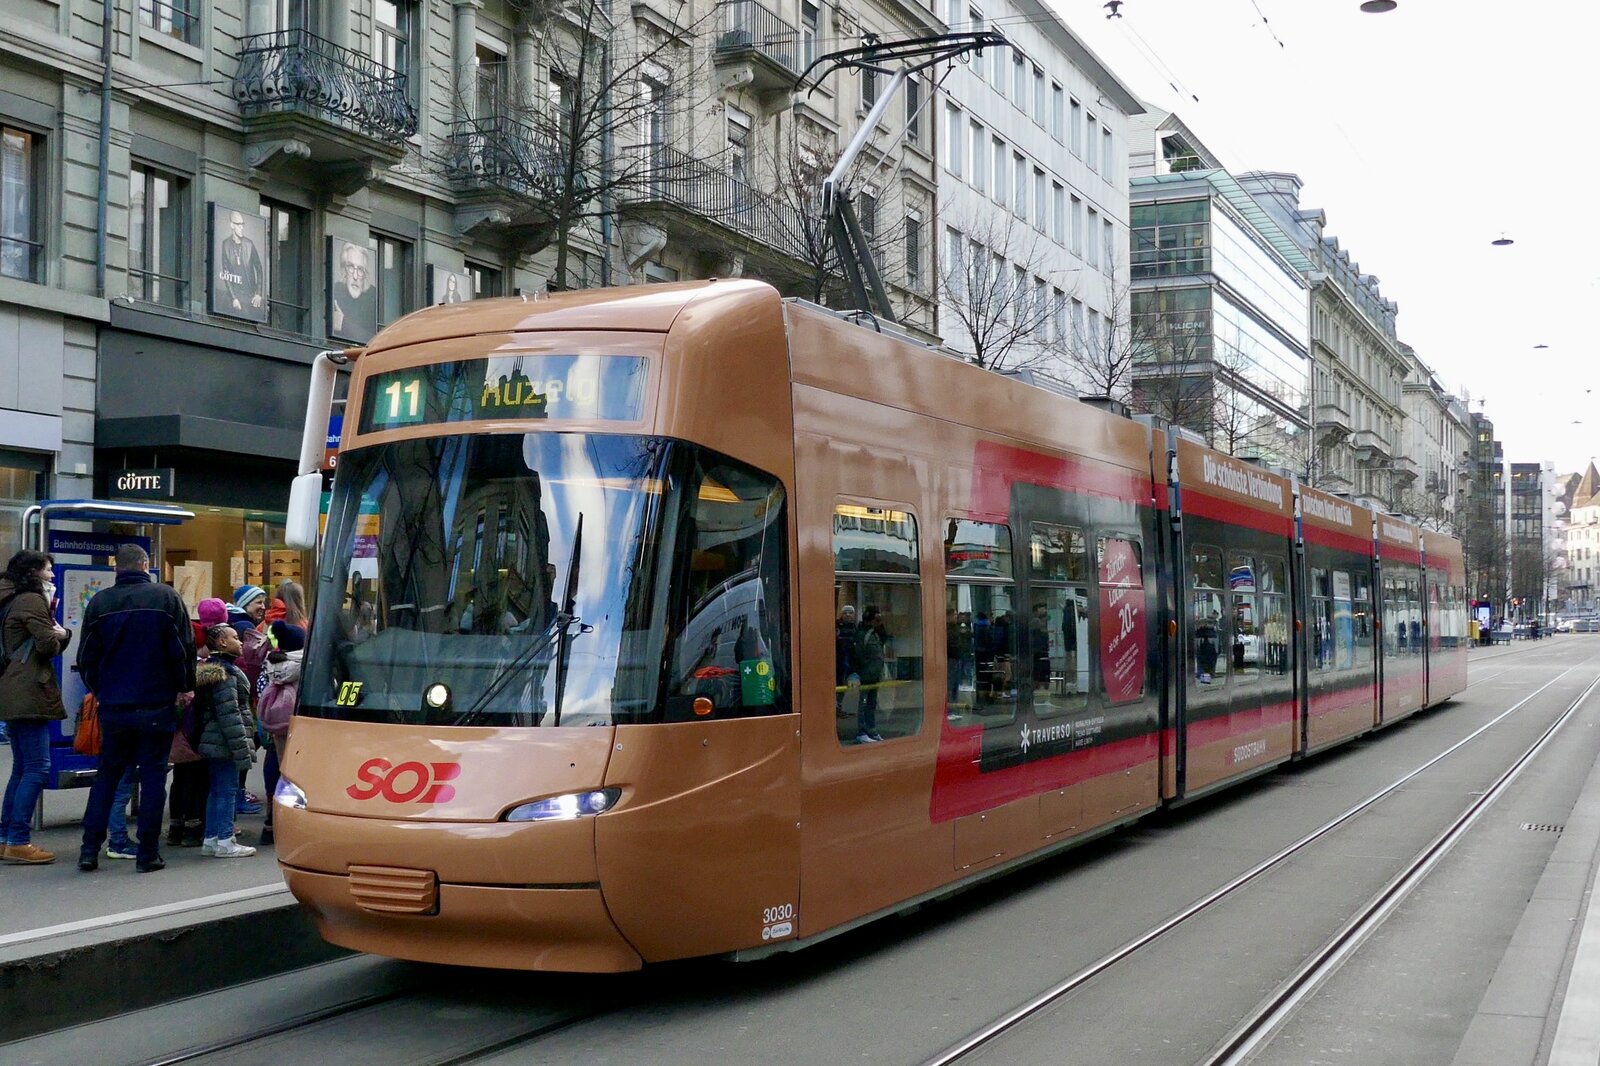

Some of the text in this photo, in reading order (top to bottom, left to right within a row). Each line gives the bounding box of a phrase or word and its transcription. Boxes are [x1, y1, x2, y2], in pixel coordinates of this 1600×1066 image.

[219, 269, 243, 286] GÖTTE
[385, 379, 420, 418] 11
[329, 455, 337, 468] 6
[1203, 454, 1217, 486] Die
[117, 473, 161, 490] GÖTTE
[338, 682, 362, 705] 05
[1032, 723, 1071, 745] TRAVERSO
[762, 903, 793, 924] 3030
